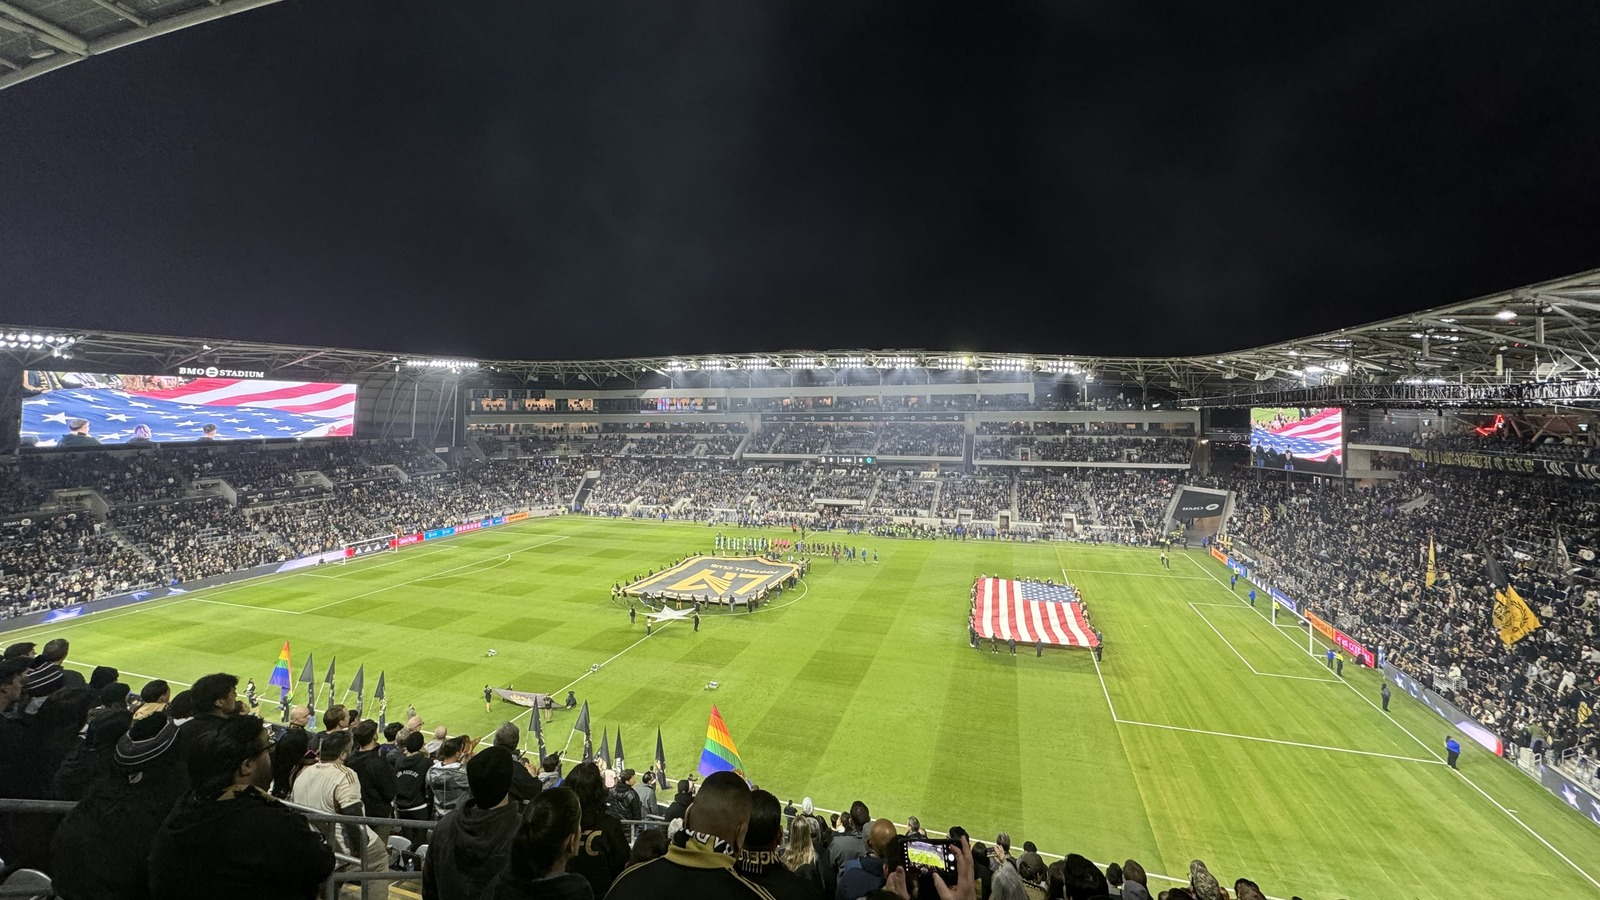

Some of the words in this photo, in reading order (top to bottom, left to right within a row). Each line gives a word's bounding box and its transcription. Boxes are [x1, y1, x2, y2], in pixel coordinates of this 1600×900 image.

[179, 367, 205, 376] BMO
[219, 369, 264, 378] STADIUM
[710, 563, 733, 571] CLUB
